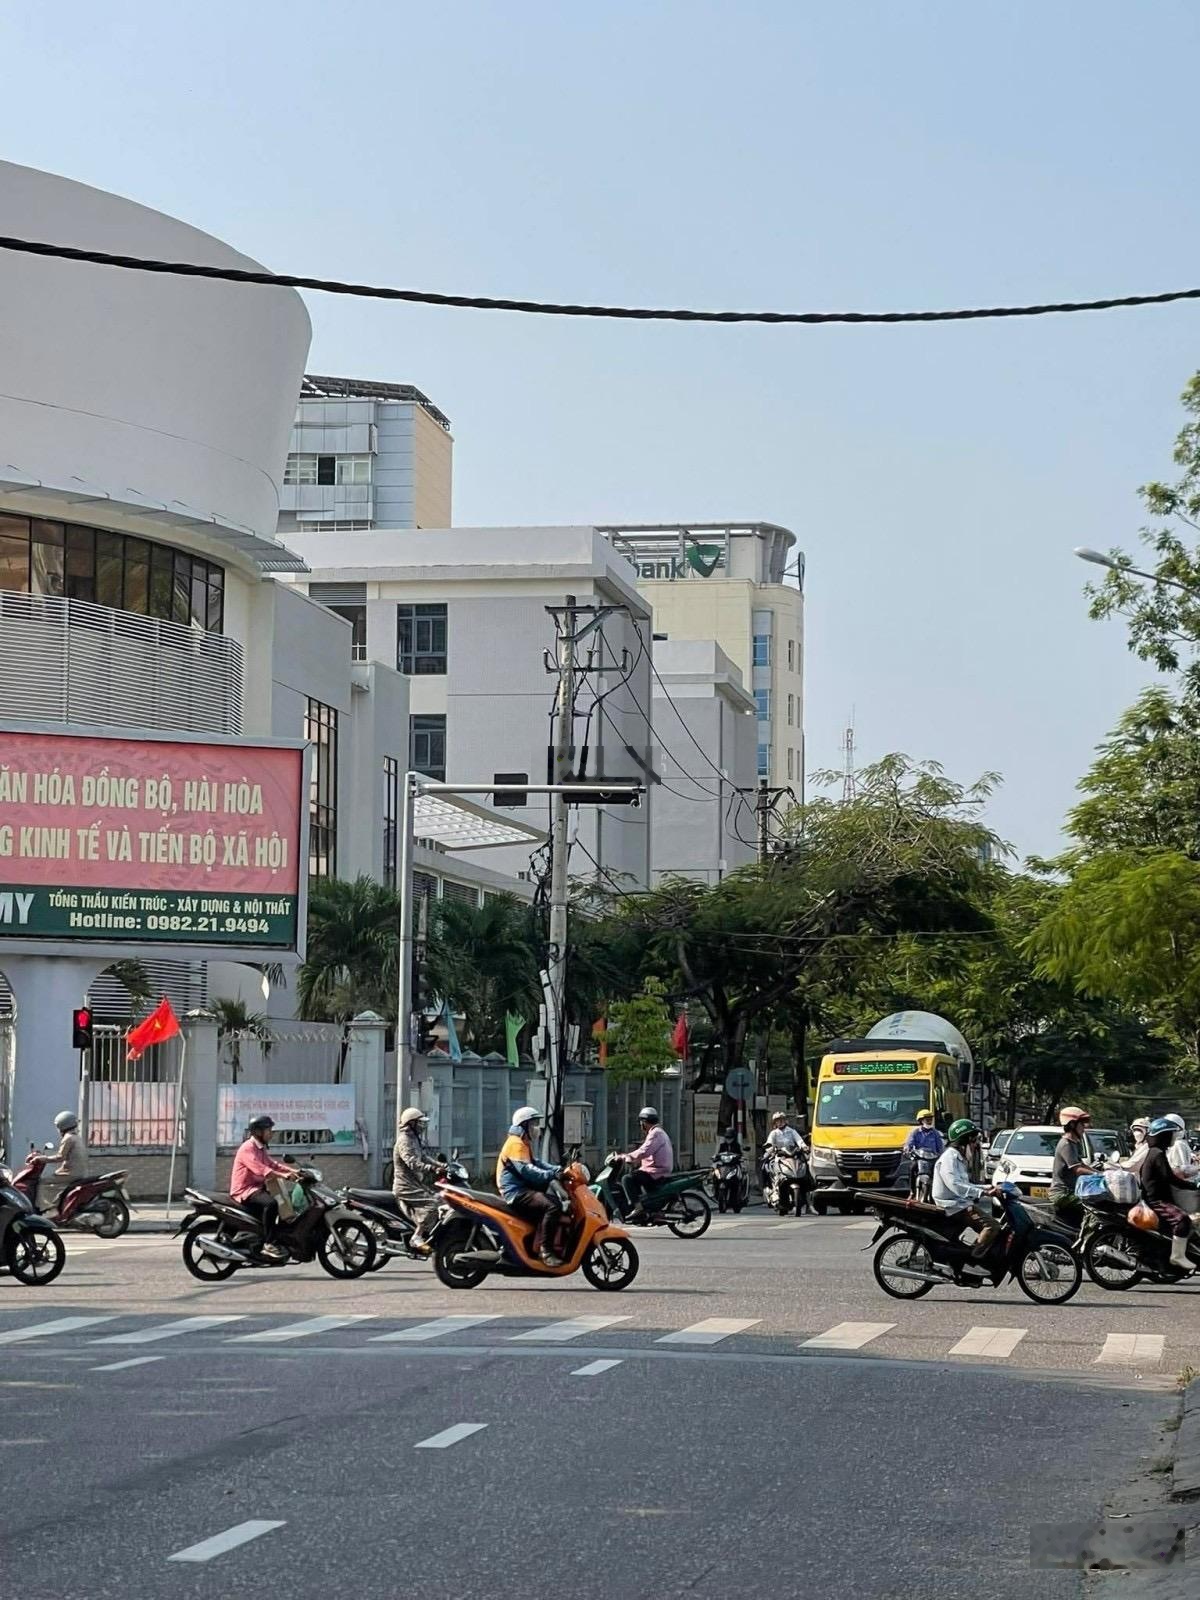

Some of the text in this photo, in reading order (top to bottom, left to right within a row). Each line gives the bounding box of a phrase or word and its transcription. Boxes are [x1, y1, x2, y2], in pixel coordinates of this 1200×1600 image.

[34, 767, 76, 805] HÓA
[82, 766, 138, 808] ĐỒNG
[144, 773, 177, 817] BỘ,
[184, 774, 218, 812] HÀI
[223, 776, 263, 814] HÒA
[20, 827, 70, 859] KINH
[77, 820, 102, 860] TẾ
[106, 824, 132, 861] VÀ
[139, 823, 184, 864] TIẾN
[190, 828, 217, 872] BỘ
[222, 830, 249, 866] XÃ
[255, 831, 288, 874] HỘI
[70, 912, 270, 933] Hotline: 0982.21.9494
[111, 892, 137, 910] KIẾN
[140, 895, 168, 911] TRÚC
[177, 896, 199, 912] XÂY
[200, 898, 230, 915] DỰNG
[232, 900, 241, 914] &
[244, 898, 263, 917] NỘI
[265, 897, 291, 915] THẤT
